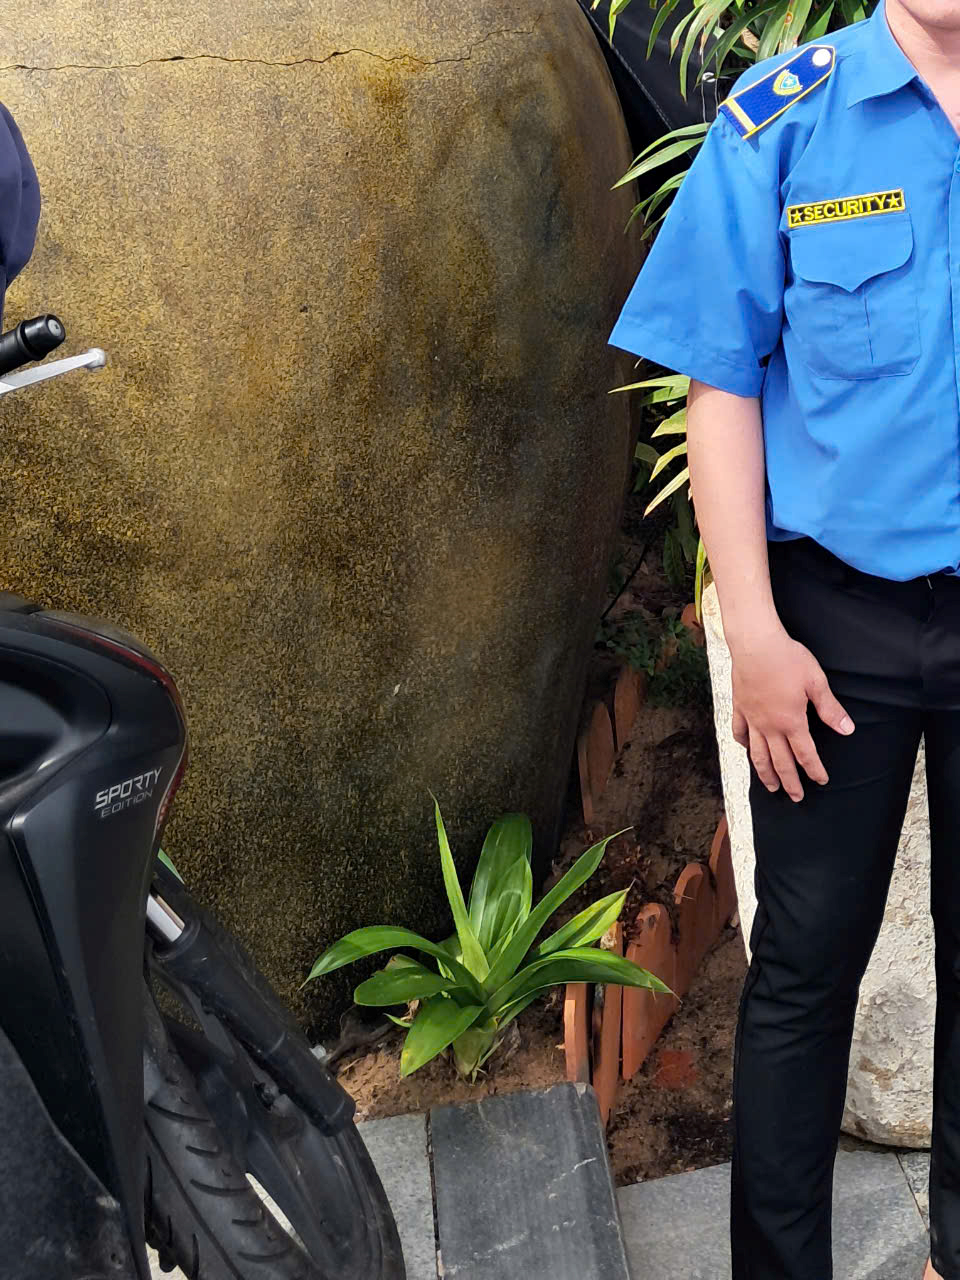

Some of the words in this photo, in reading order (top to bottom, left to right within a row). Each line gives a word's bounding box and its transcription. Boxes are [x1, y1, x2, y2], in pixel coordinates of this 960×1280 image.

[802, 195, 887, 221] SECURITY
[94, 767, 162, 809] SPORTY
[101, 789, 153, 818] EDITION
